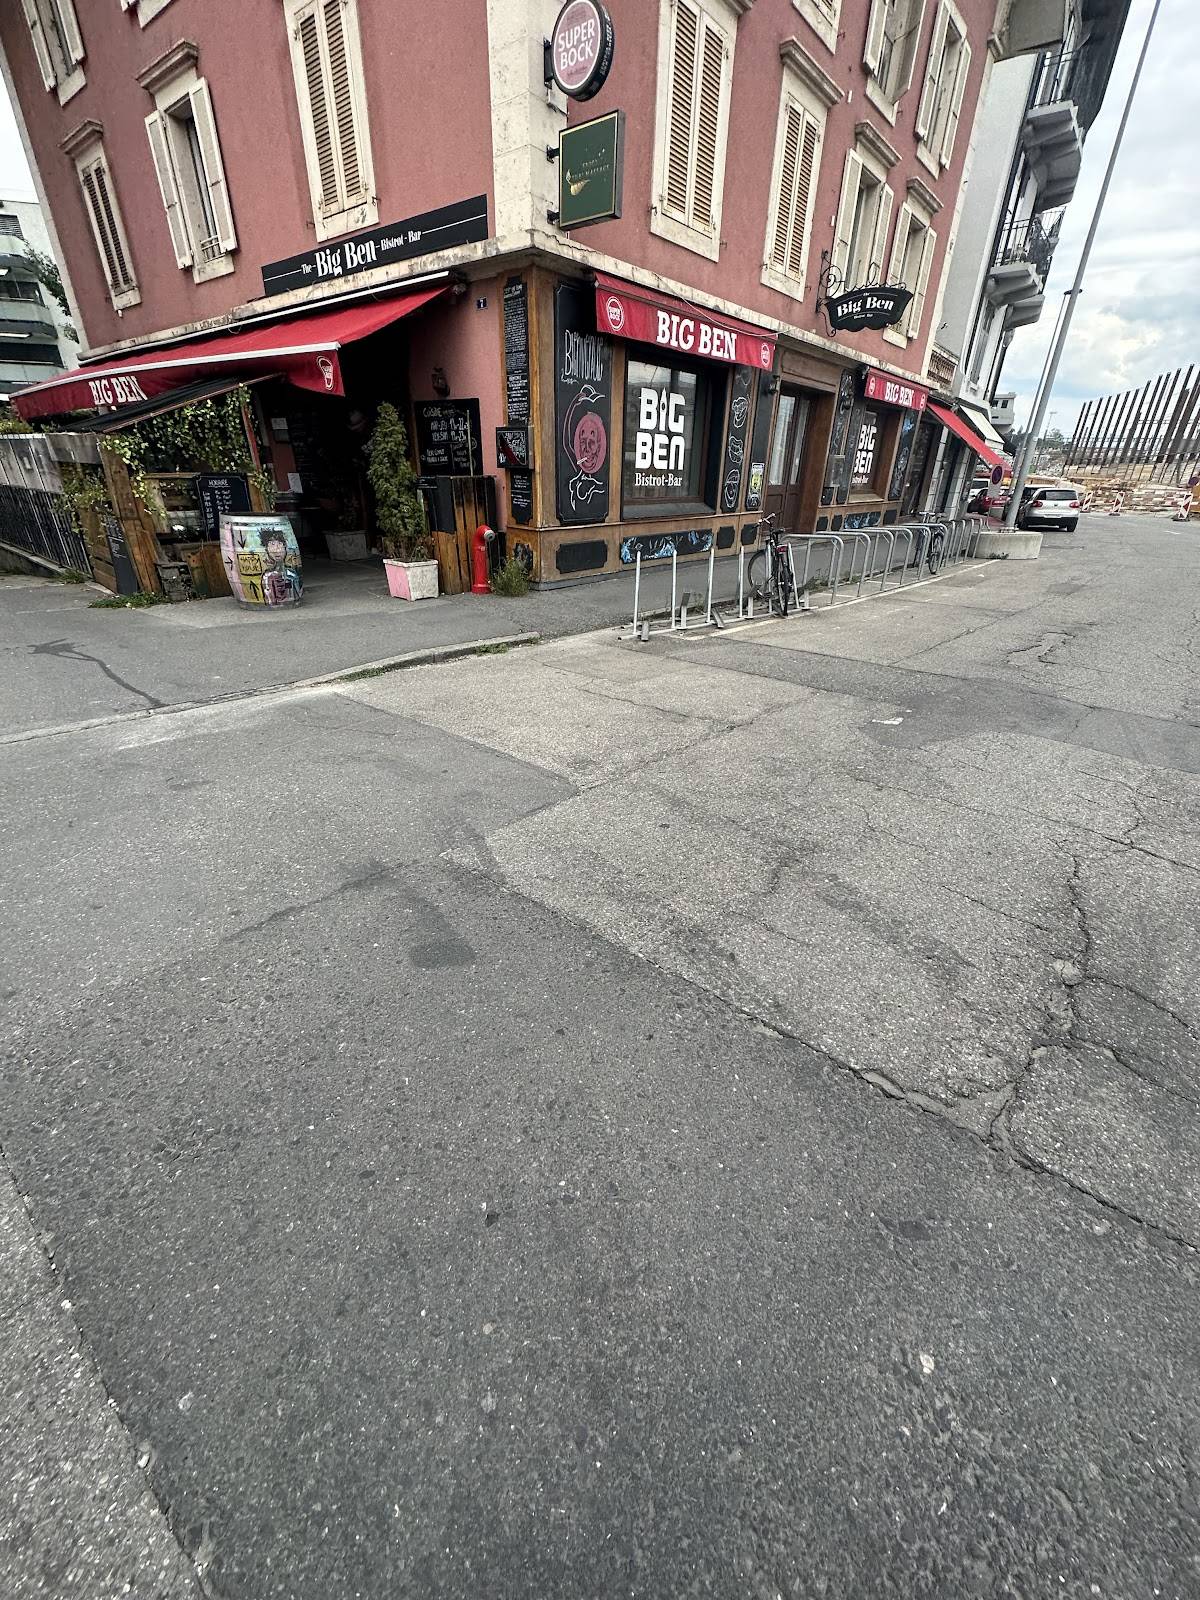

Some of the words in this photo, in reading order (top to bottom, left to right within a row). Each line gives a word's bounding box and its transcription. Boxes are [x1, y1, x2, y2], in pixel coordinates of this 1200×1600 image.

[558, 19, 595, 52] SUPER
[561, 39, 593, 70] BOCK
[314, 248, 342, 277] Big
[344, 240, 377, 269] Ben
[837, 299, 862, 317] Big
[866, 296, 894, 311] Ben
[656, 310, 695, 350] BIG
[698, 324, 738, 360] BEN
[88, 378, 113, 405] BIG
[110, 375, 148, 403] BEN
[885, 381, 900, 402] BIG
[899, 386, 914, 407] BEN
[639, 387, 685, 433] BIG
[635, 431, 685, 470] BEN
[858, 424, 877, 450] BIG
[635, 472, 682, 486] Bistrot-Bar
